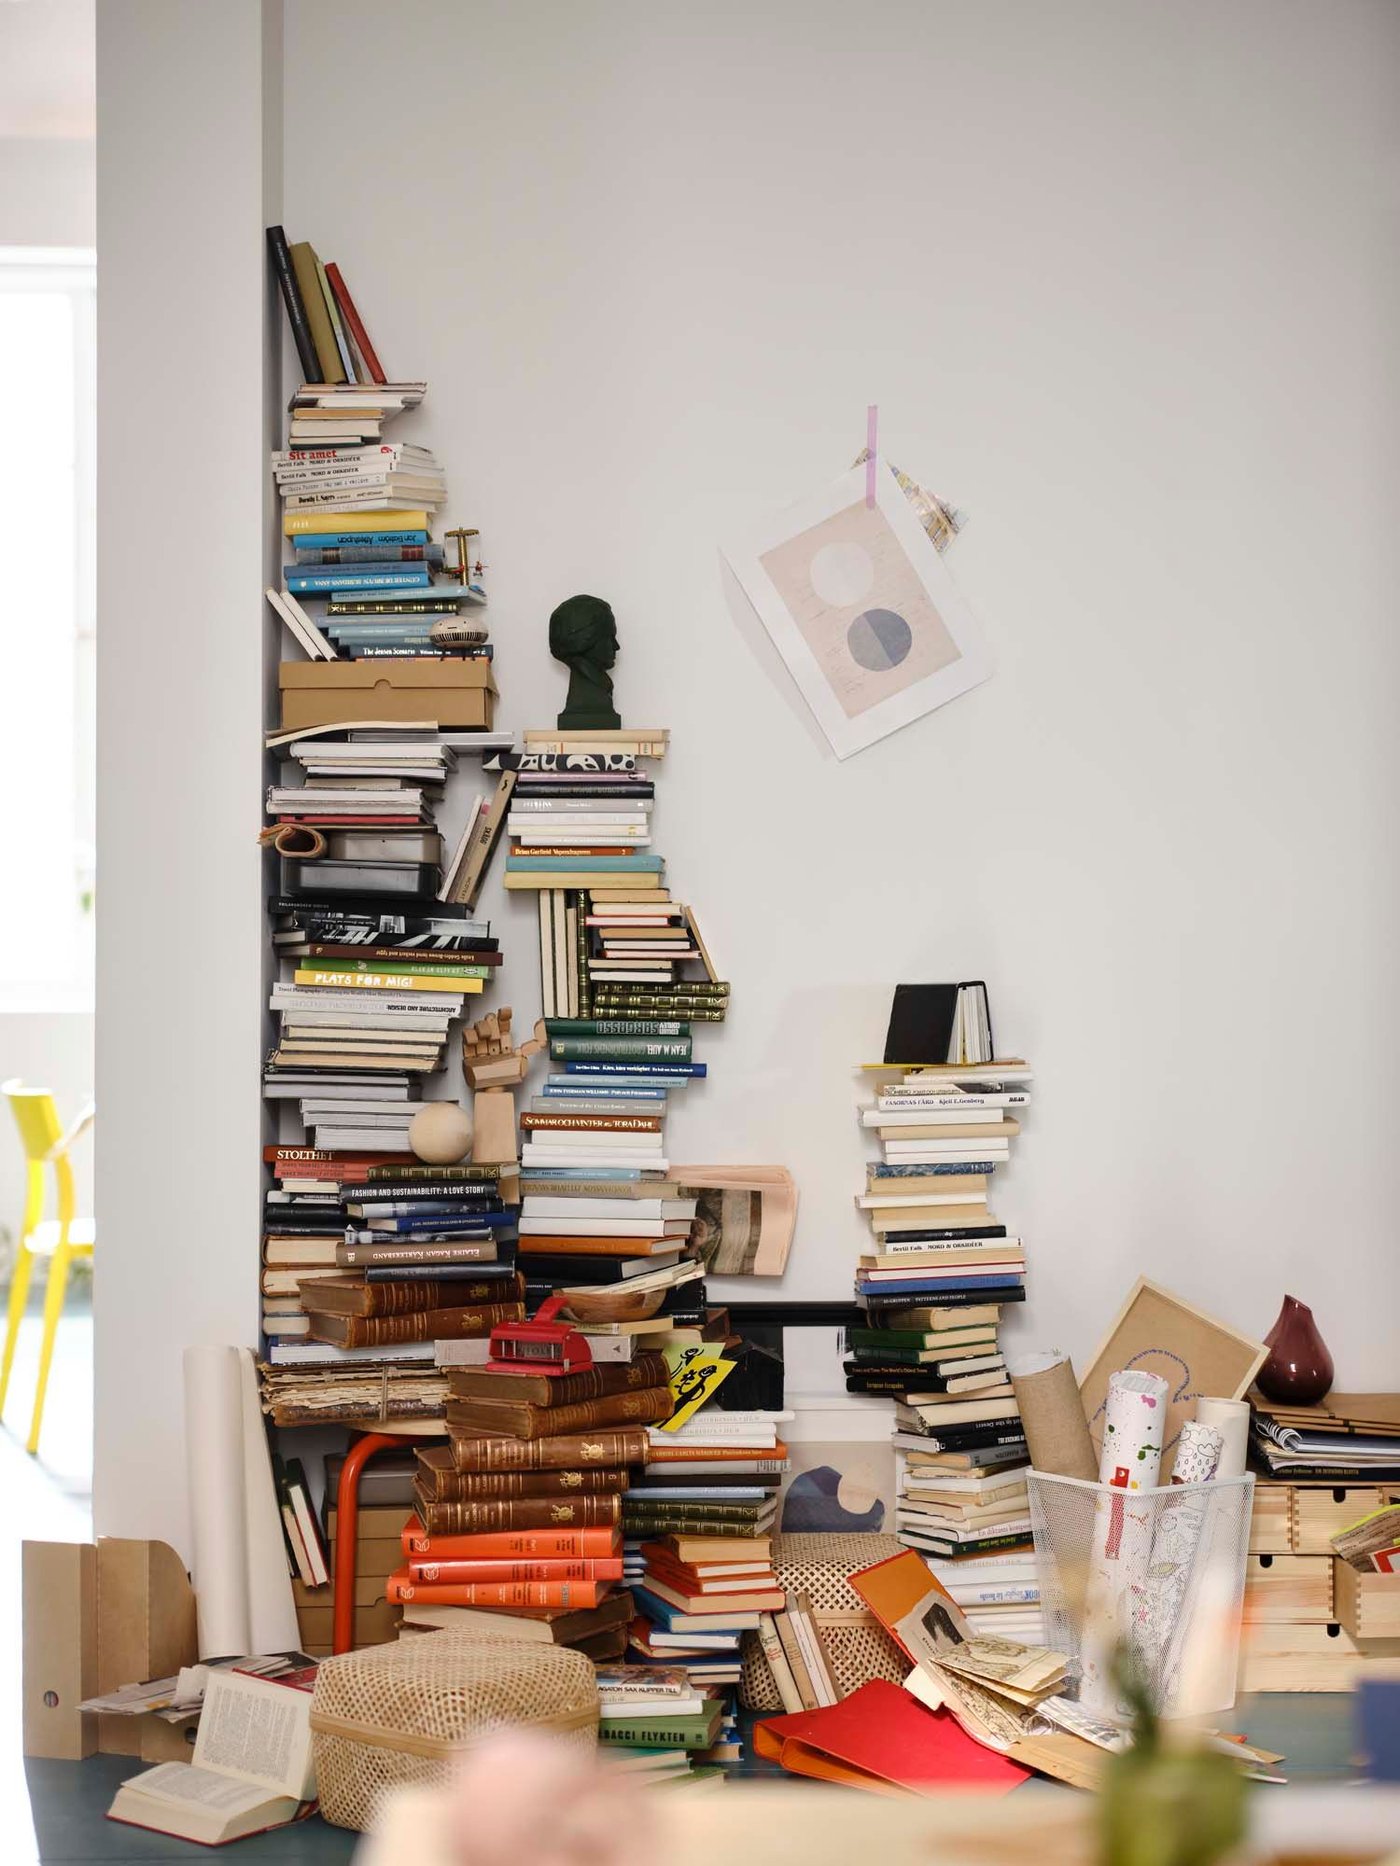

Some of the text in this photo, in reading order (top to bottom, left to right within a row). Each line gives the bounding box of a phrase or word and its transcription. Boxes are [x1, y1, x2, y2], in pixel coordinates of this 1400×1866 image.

[288, 450, 337, 460] Sit amet
[404, 534, 417, 542] Jan
[315, 973, 413, 988] PLATS FÖR MIG!
[596, 1021, 659, 1034] SARGASSO
[670, 1044, 688, 1056] JEAN
[277, 1150, 333, 1160] STOLTHET
[352, 1189, 377, 1197] FASHION
[392, 1187, 442, 1196] SUSTAINABILITY:
[465, 1186, 485, 1195] STORY
[426, 1250, 451, 1258] KAGAN
[452, 1248, 480, 1258] ELAINE
[642, 1731, 685, 1742] FLYKTEN
